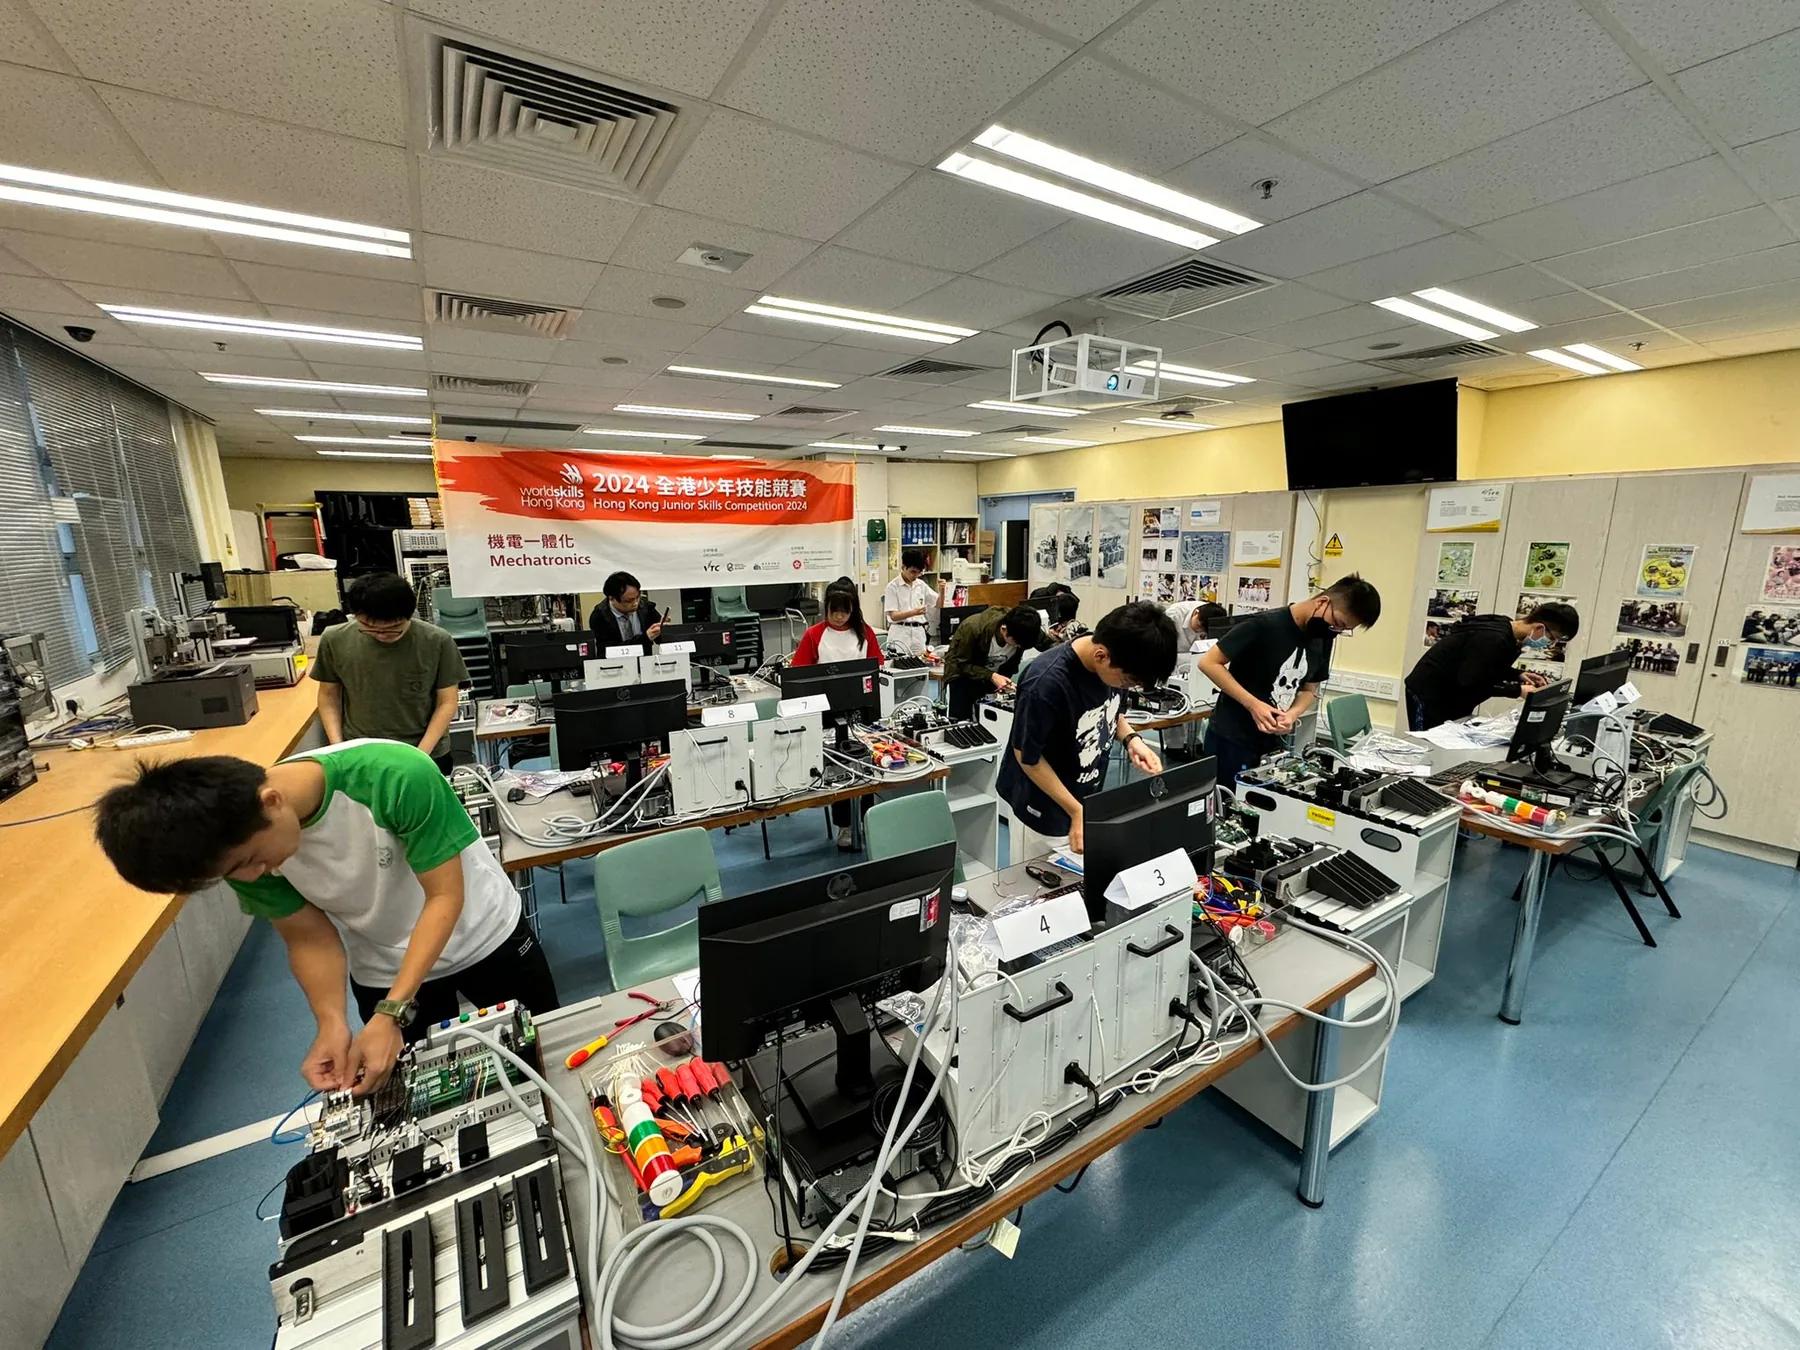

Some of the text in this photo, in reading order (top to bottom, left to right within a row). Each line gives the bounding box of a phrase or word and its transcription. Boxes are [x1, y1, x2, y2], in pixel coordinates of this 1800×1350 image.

[520, 485, 584, 498] worldskills
[592, 472, 807, 498] 2024 全港少年技能競賽
[521, 497, 585, 512] Hong Kong
[593, 498, 807, 513] Hong Kong Junior Skills Competition 2024
[487, 533, 575, 549] 機電一體化
[489, 553, 592, 567] Mechatronics
[801, 701, 808, 710] 7
[727, 709, 735, 719] 8
[1153, 869, 1166, 887] 3
[1039, 914, 1051, 934] 4
